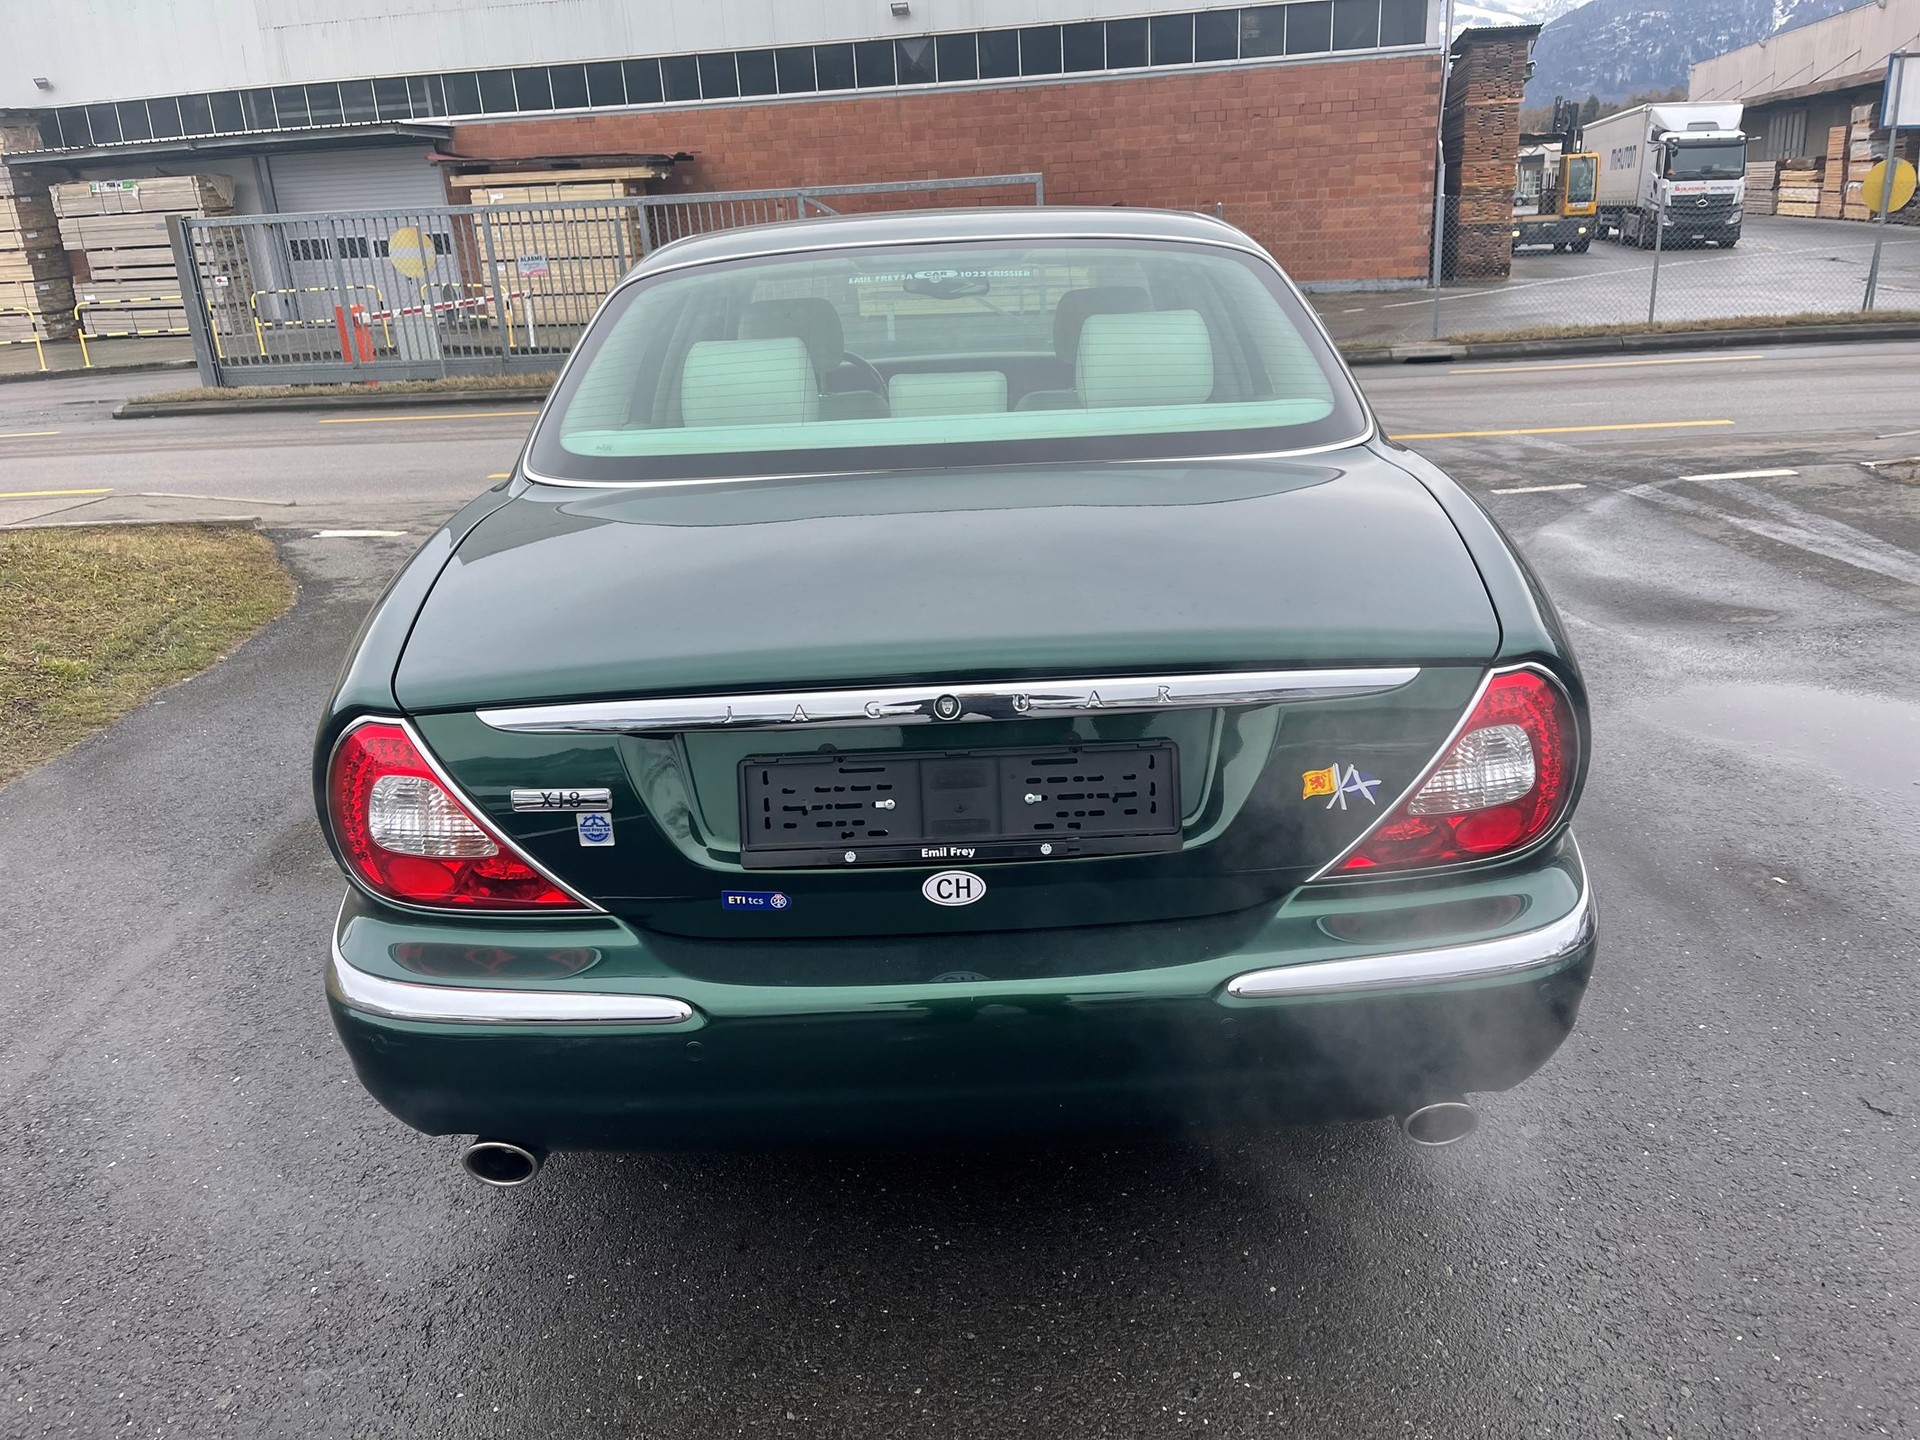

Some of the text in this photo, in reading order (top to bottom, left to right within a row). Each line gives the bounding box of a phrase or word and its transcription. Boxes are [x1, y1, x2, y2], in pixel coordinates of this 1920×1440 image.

[848, 275, 872, 285] EMIL
[875, 273, 899, 282] FREY
[900, 273, 914, 281] SA
[540, 791, 581, 808] XJ8
[921, 846, 976, 858] Emil Frey
[936, 877, 972, 900] CH
[727, 896, 765, 905] ETI tcs
